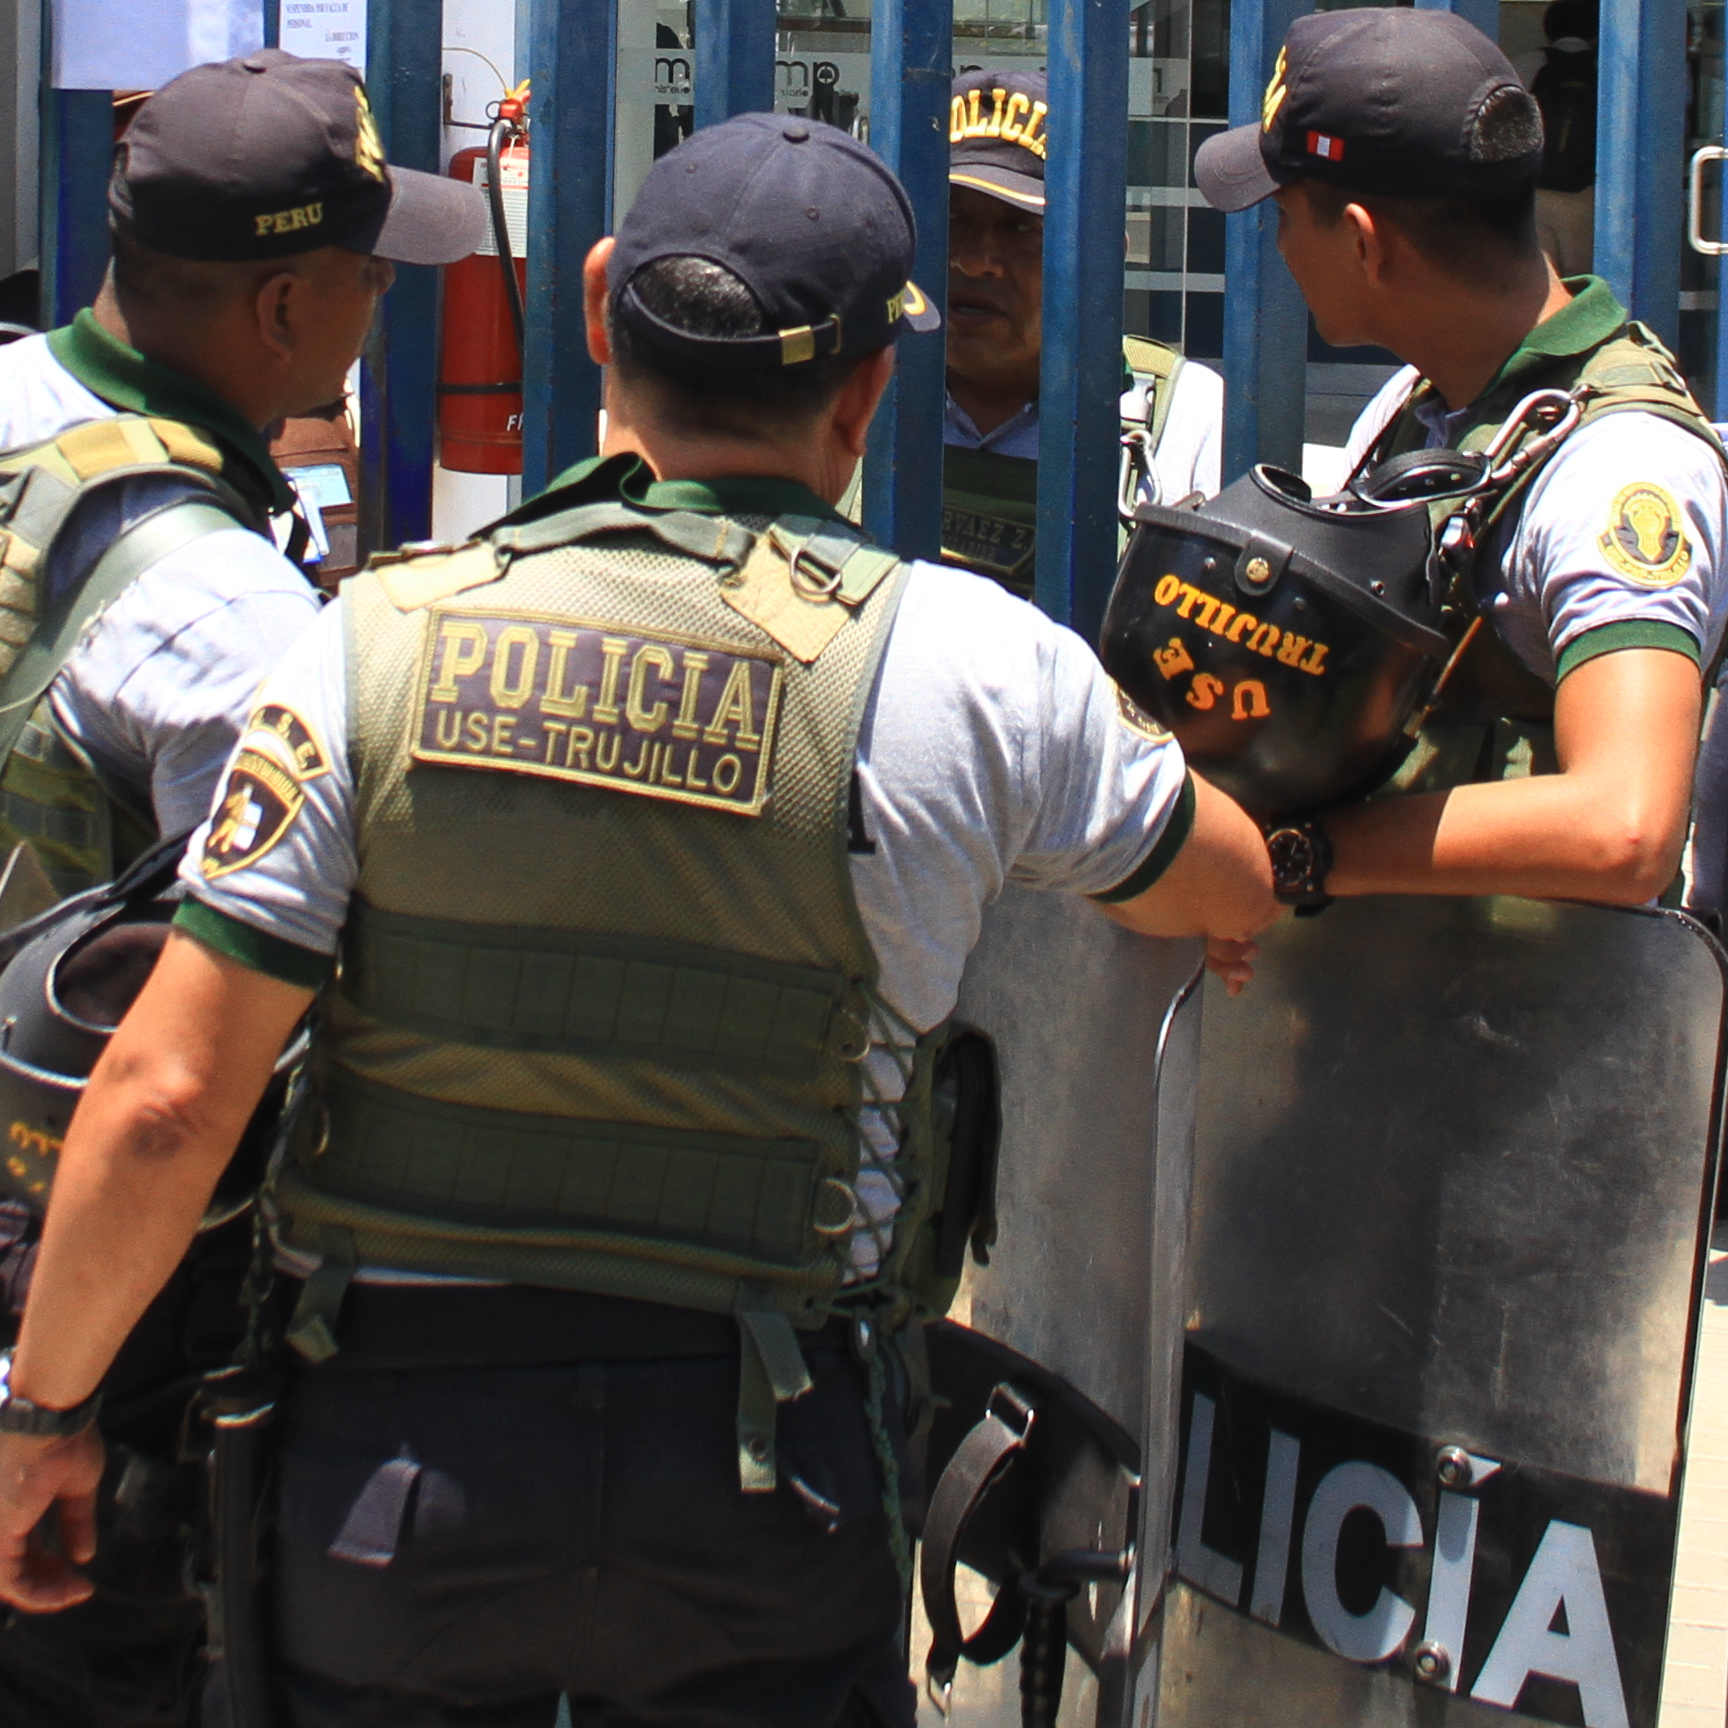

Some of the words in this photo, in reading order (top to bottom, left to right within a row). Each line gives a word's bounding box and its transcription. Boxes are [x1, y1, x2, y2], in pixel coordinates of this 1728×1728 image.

[255, 202, 323, 236] PERU
[1154, 574, 1330, 676] TRUJILLO
[430, 621, 761, 752] POLICIA
[1153, 637, 1270, 721] USE
[436, 708, 743, 794] USE-TRUJILLO
